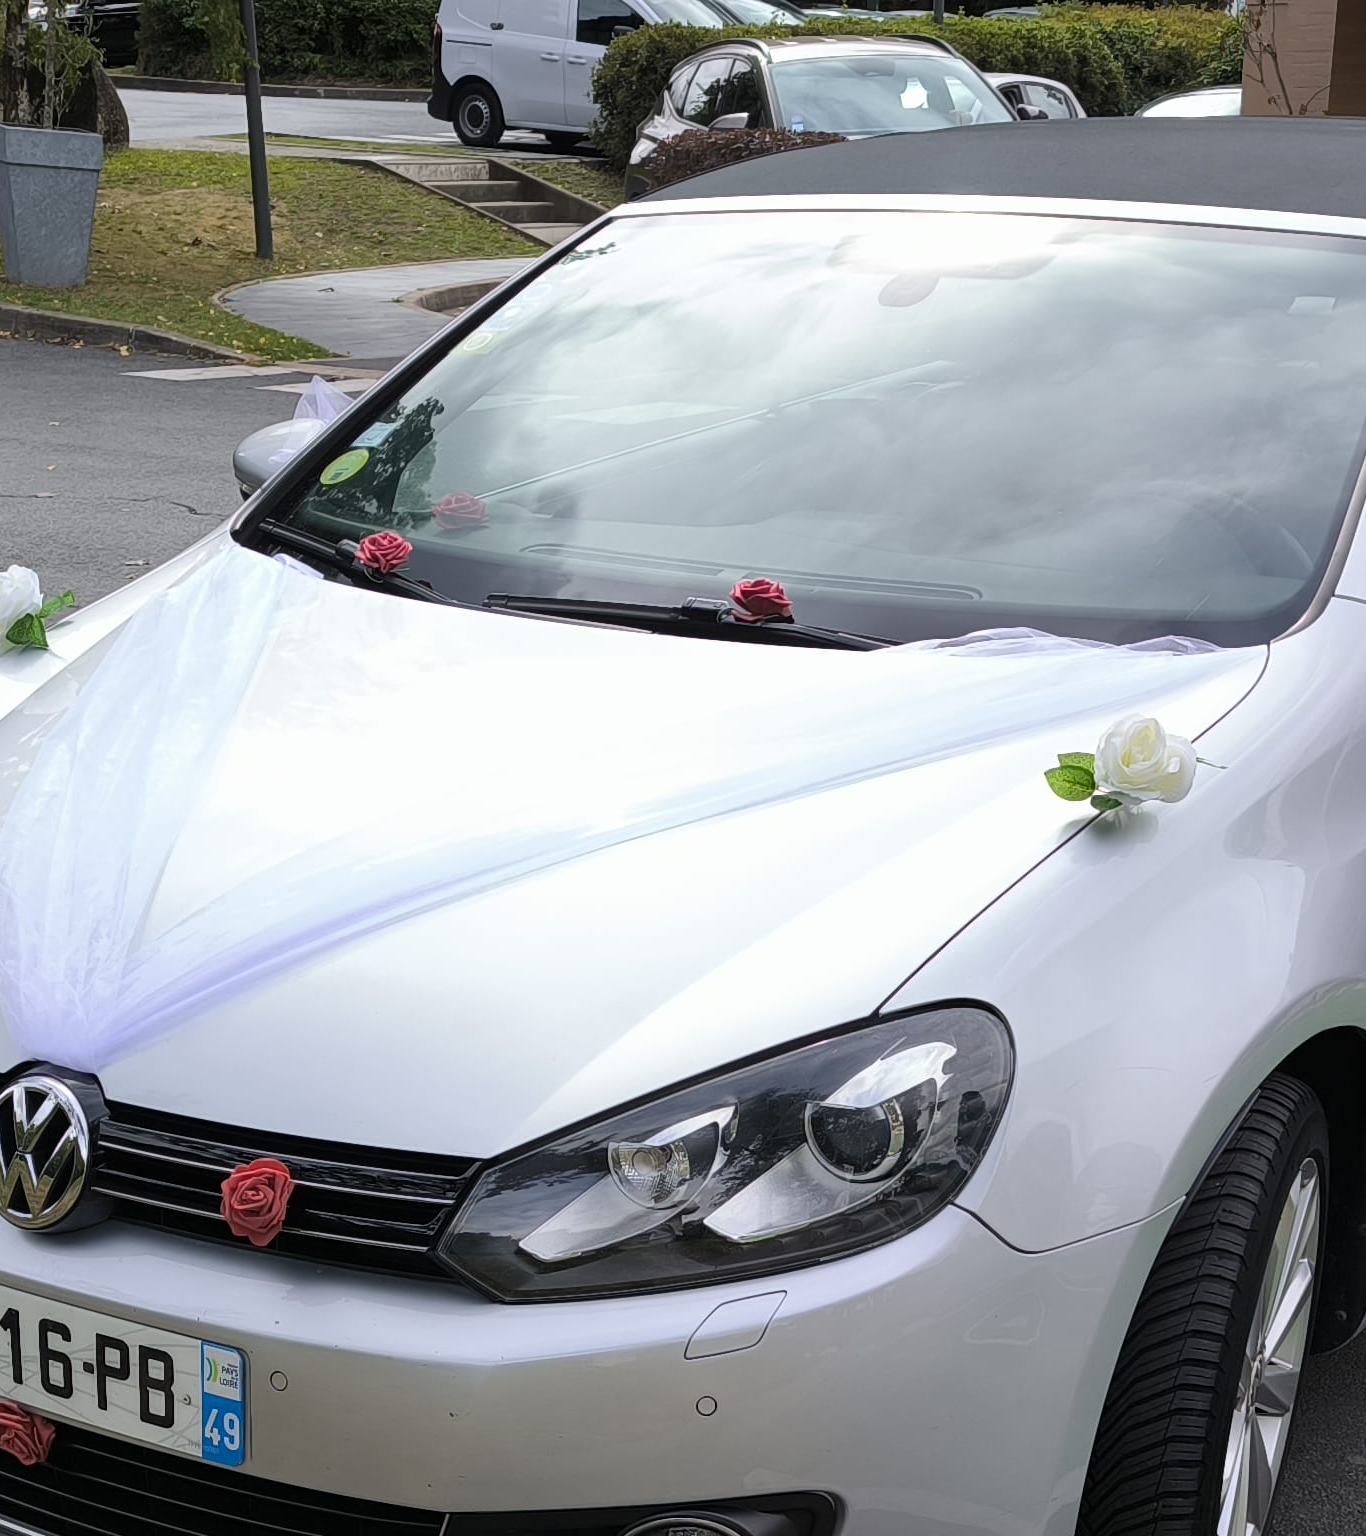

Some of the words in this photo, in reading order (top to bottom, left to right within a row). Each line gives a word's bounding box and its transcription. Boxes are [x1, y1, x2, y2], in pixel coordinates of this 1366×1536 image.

[221, 1365, 239, 1377] PAYS
[219, 1377, 239, 1390] LOIRE
[204, 1408, 240, 1451] 49
